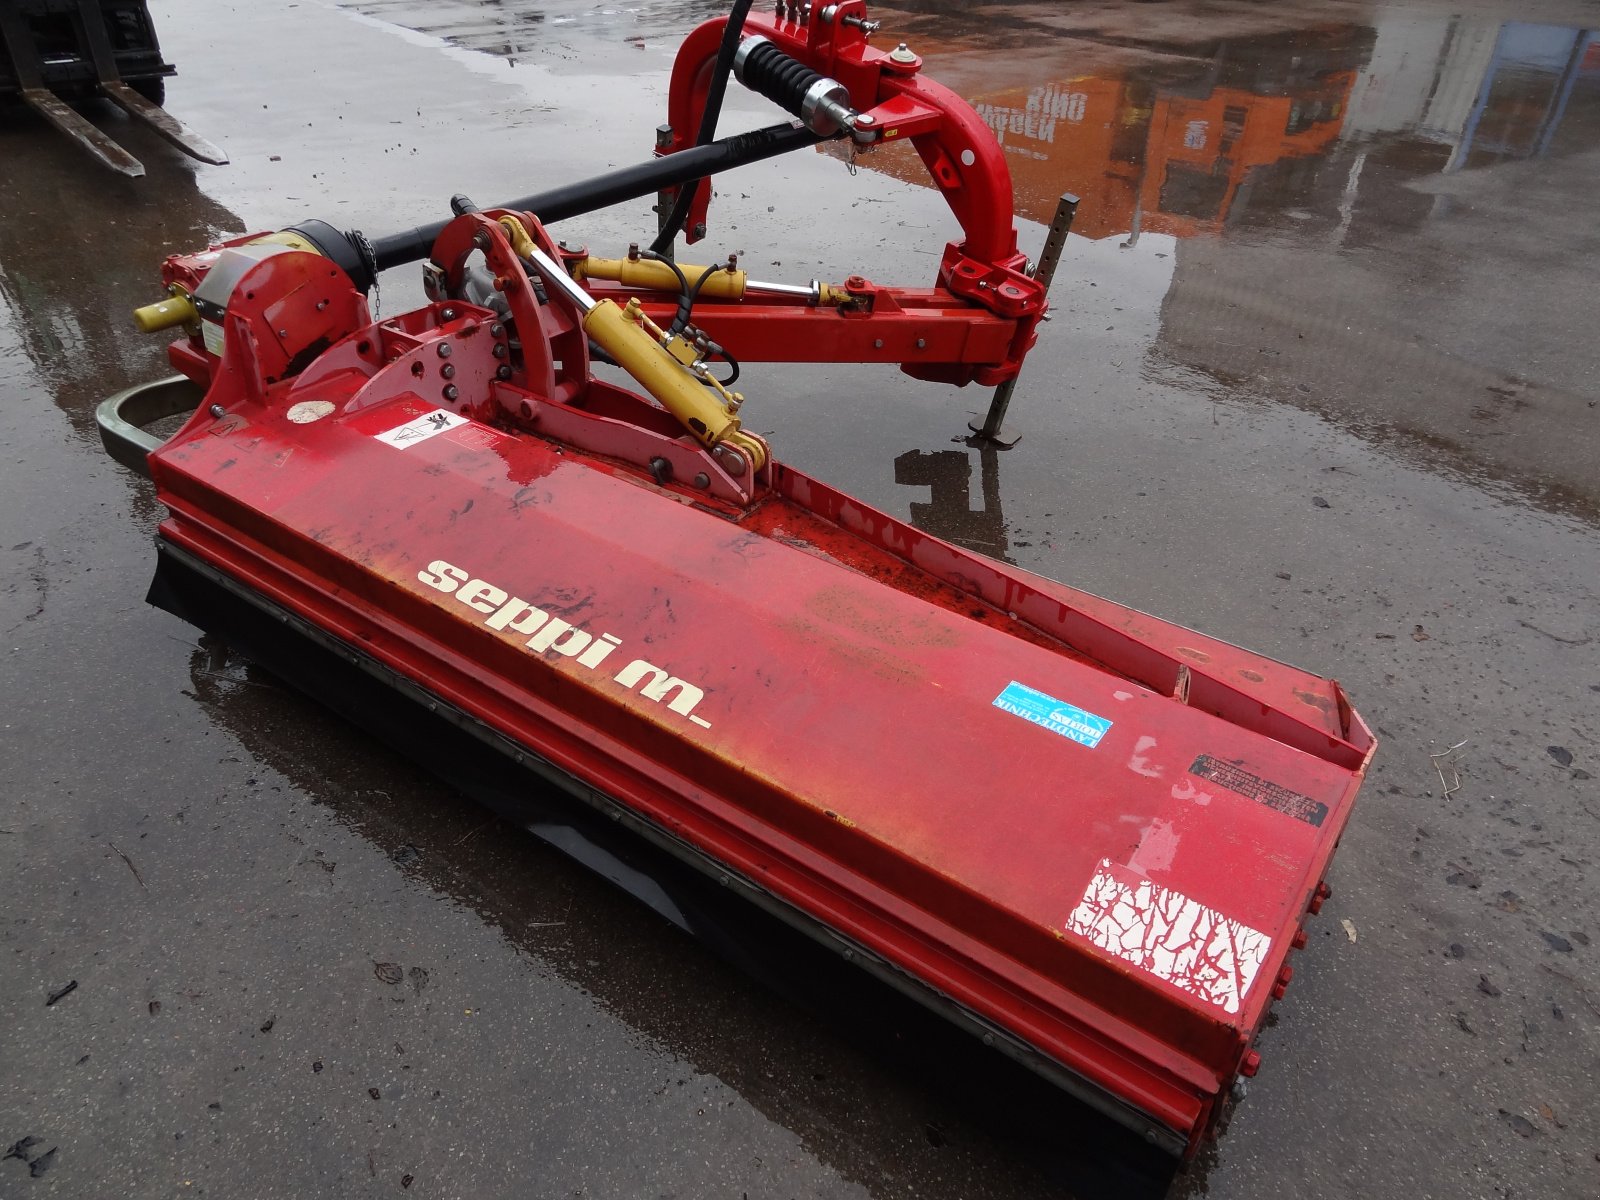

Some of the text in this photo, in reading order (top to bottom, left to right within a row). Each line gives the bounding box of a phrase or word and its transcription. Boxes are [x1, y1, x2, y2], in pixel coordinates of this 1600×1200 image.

[416, 559, 623, 670] seppi
[996, 698, 1097, 747] LANDTECHNIK
[1052, 711, 1099, 736] TOBIAS
